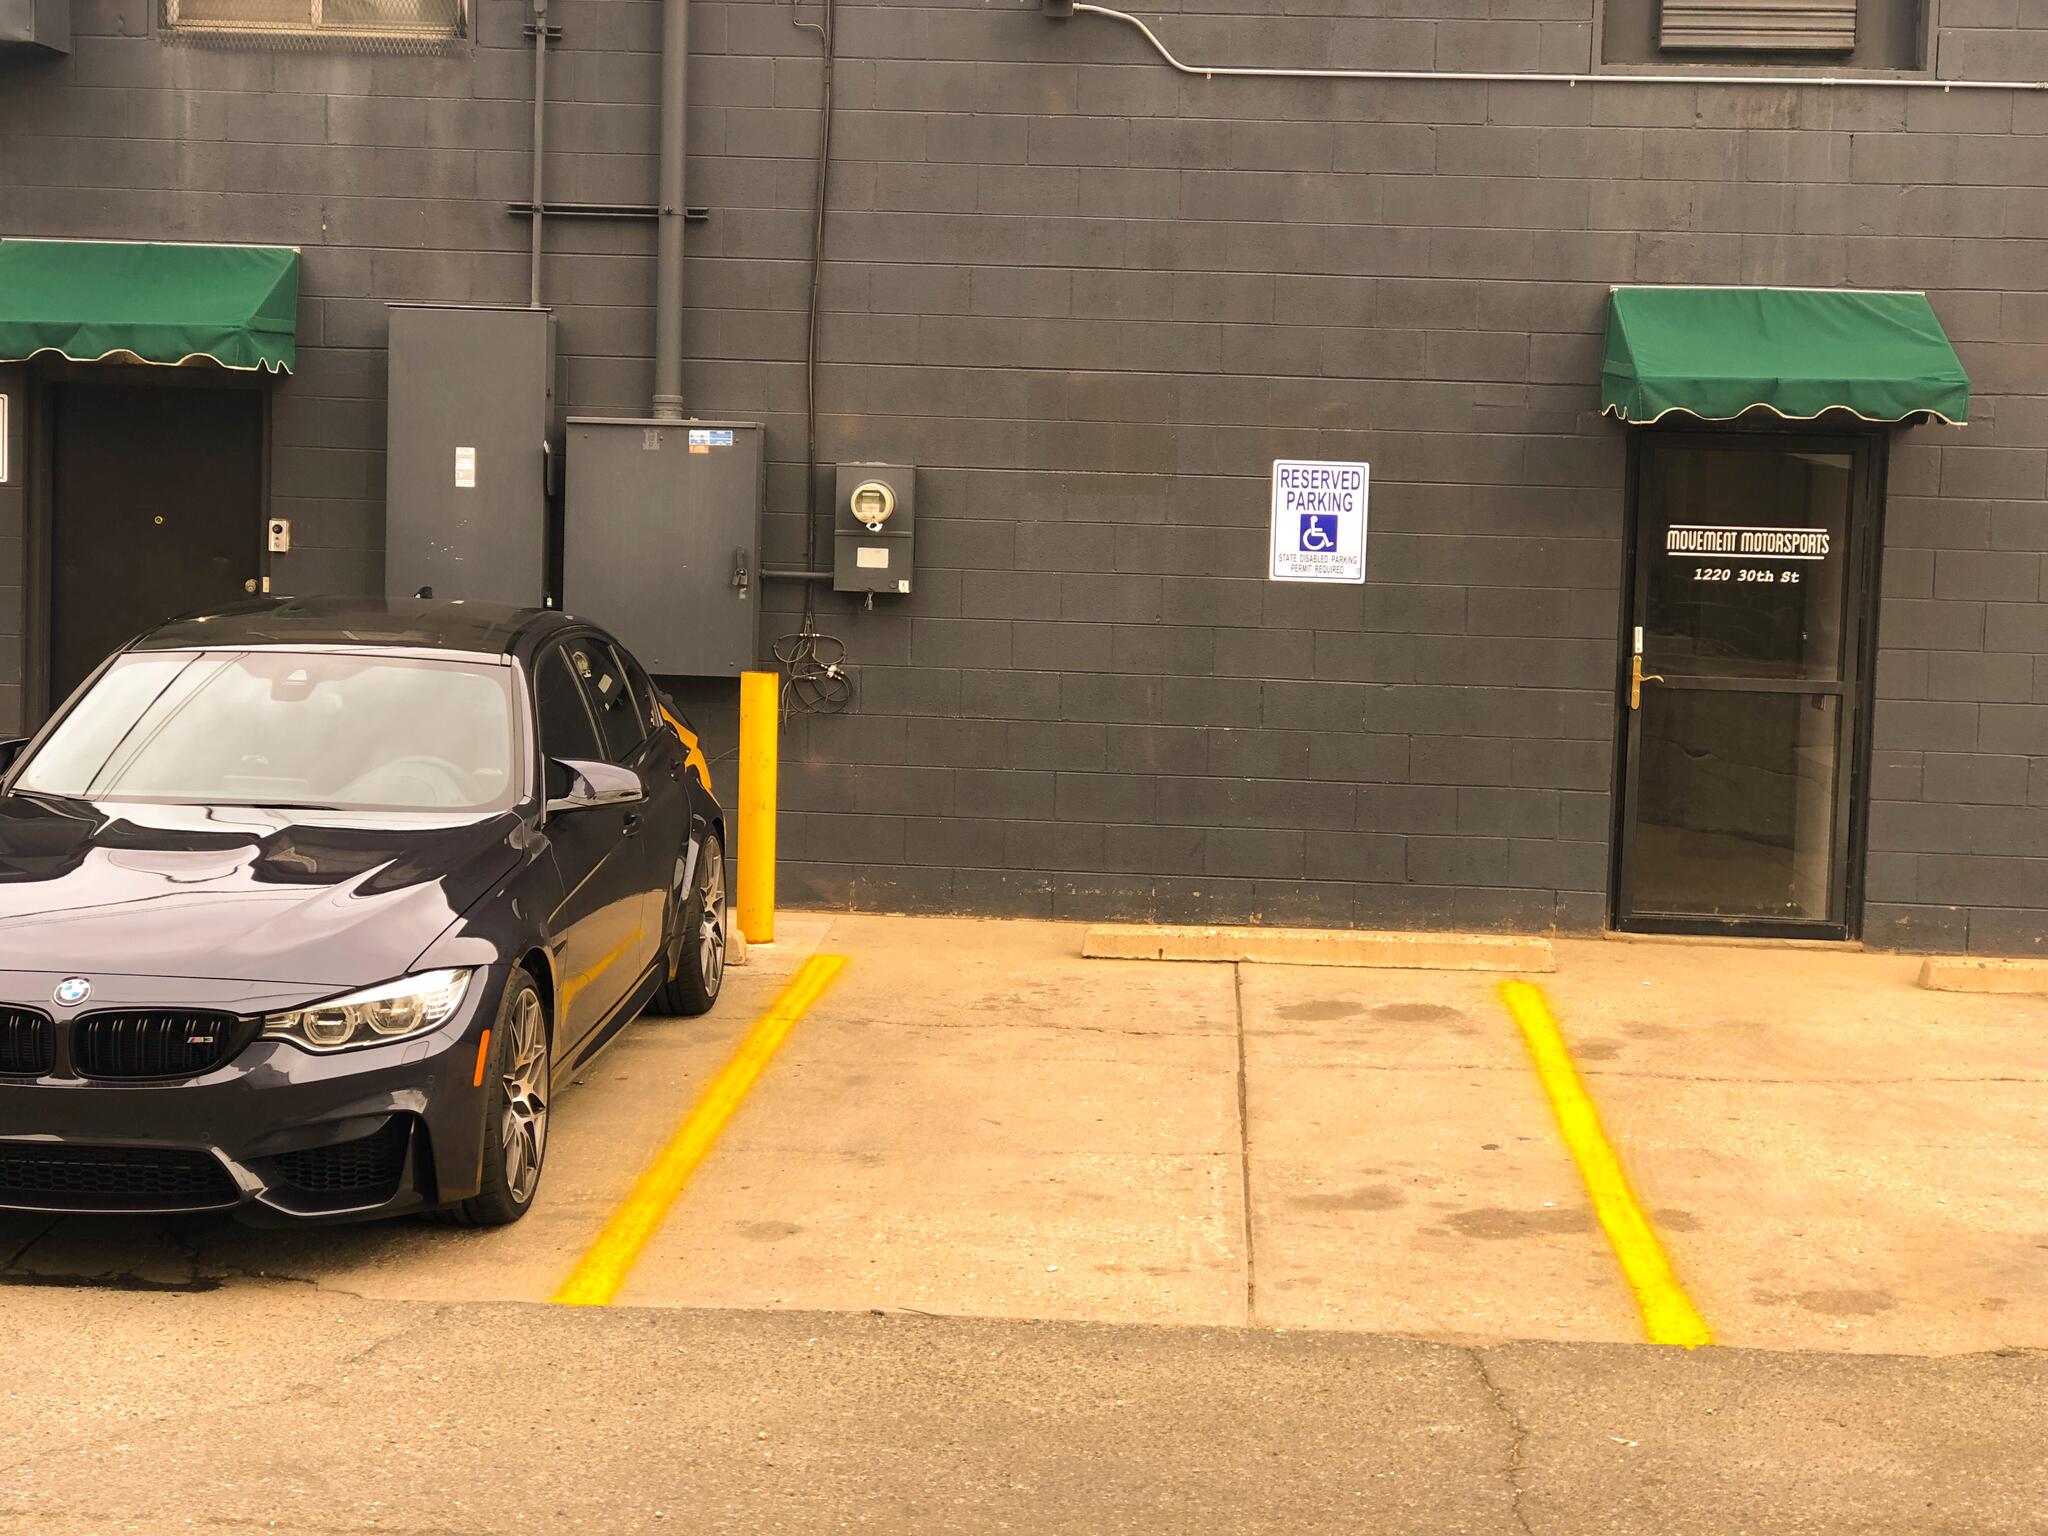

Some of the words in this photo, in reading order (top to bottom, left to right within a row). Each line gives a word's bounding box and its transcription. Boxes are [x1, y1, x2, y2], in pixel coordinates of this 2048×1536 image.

[1280, 468, 1361, 490] RESERVED
[1286, 491, 1353, 512] PARKING
[1666, 530, 1738, 552] MOVEMENT
[1740, 532, 1830, 554] MOTORSPORTS
[1278, 553, 1297, 563] STATE
[1299, 554, 1329, 563] DISABLED
[1331, 555, 1358, 565] PARKING
[1290, 564, 1312, 573] PERMIT
[1314, 565, 1344, 574] REQUIRED
[1693, 568, 1731, 581] 1220
[1737, 569, 1774, 582] 30th
[1780, 571, 1800, 583] St
